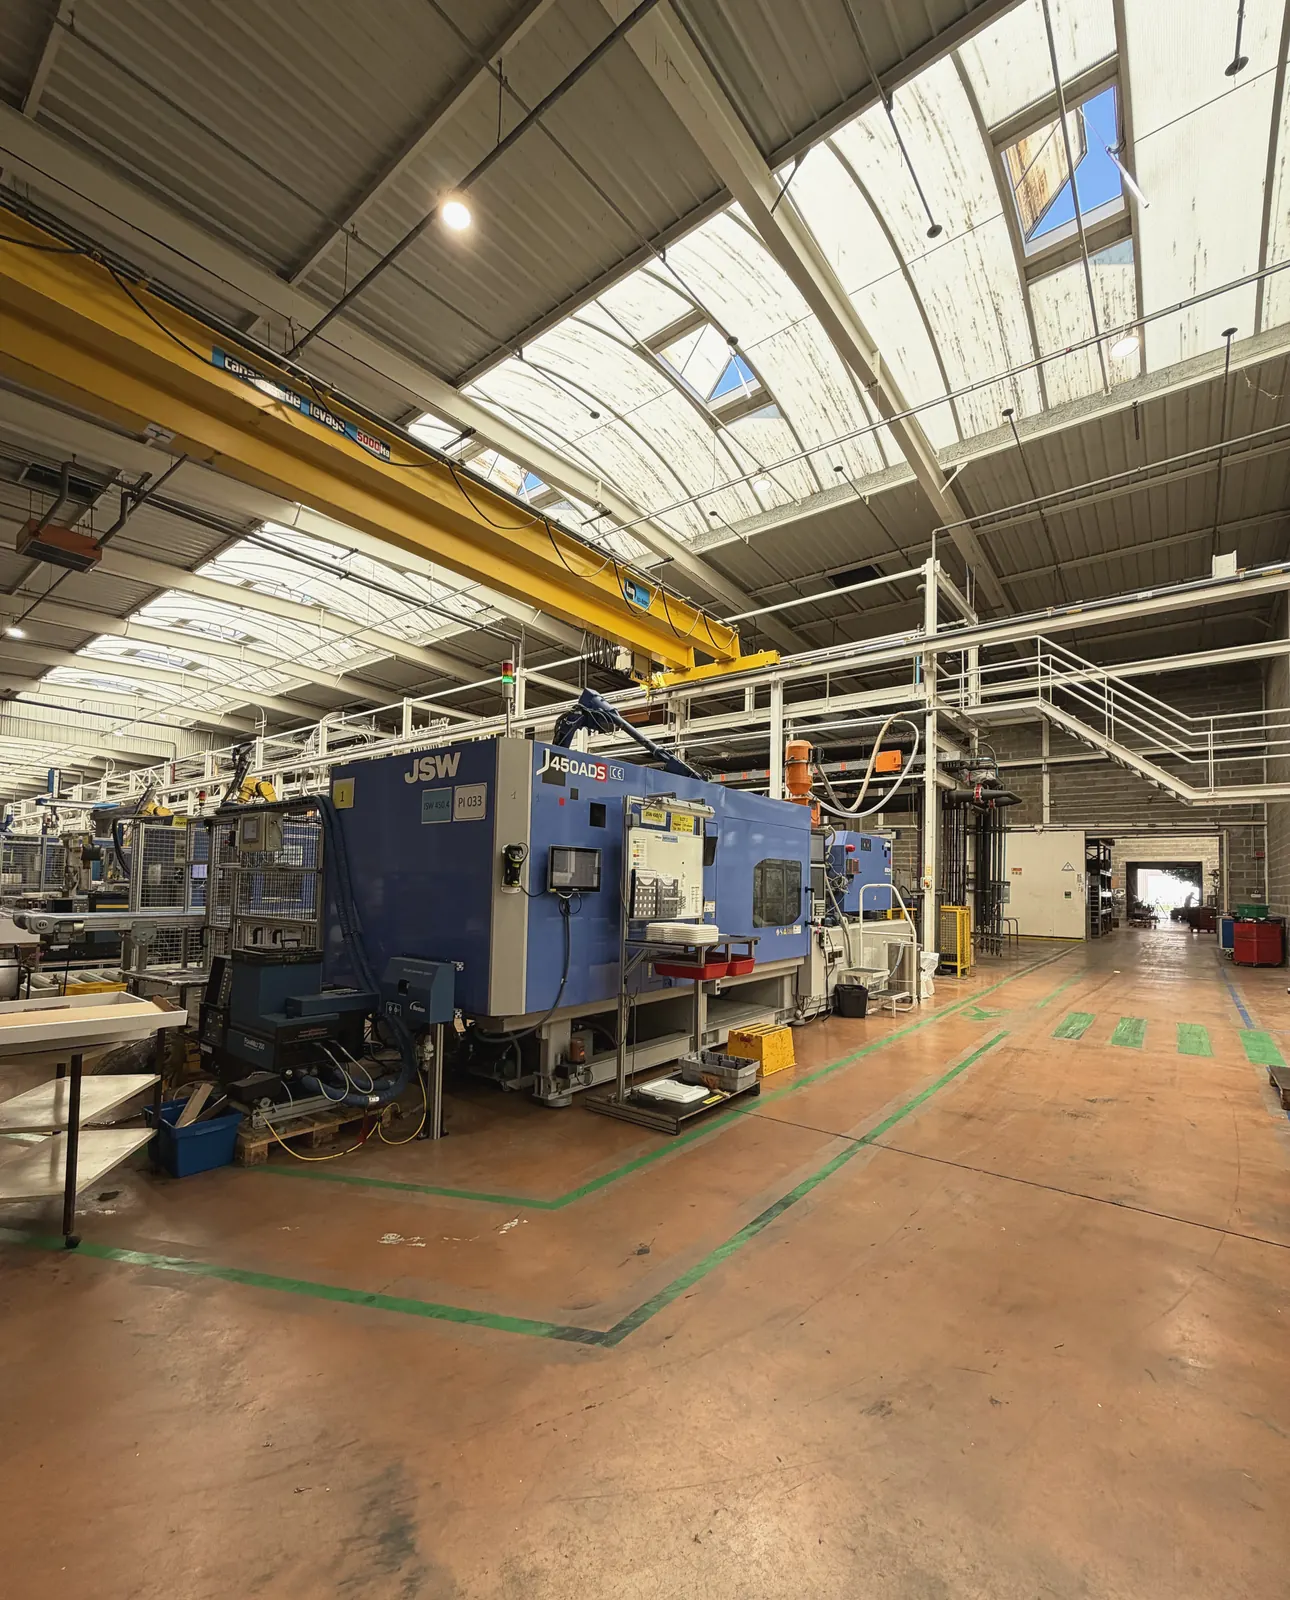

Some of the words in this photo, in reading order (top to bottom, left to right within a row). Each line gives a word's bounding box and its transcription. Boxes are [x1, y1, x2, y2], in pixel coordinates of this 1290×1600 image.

[404, 752, 461, 784] JSW
[536, 748, 606, 780] J450ADS
[340, 790, 345, 803] 1
[458, 796, 465, 808] PI
[467, 795, 482, 807] 033
